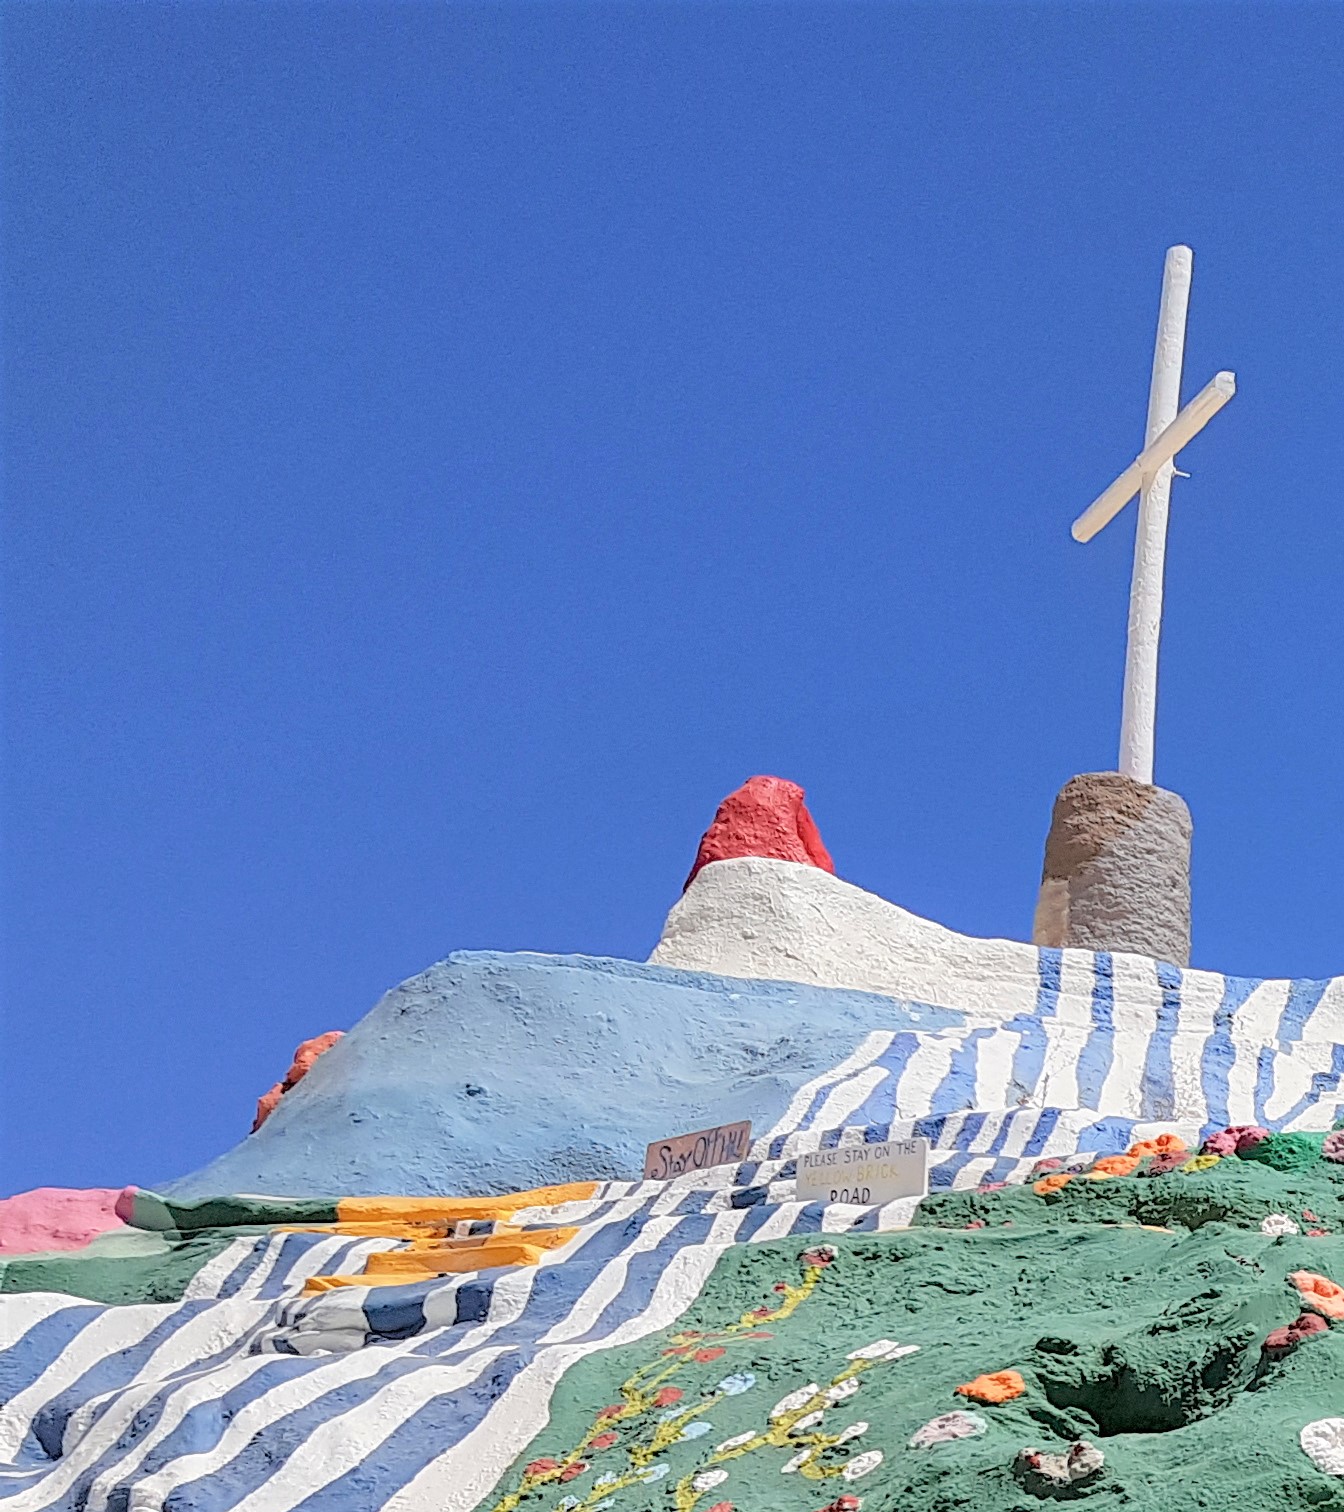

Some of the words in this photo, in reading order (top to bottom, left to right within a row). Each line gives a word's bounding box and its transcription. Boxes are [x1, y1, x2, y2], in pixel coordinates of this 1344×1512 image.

[651, 1145, 692, 1179] Stay
[803, 1152, 838, 1168] PLEASE
[844, 1148, 871, 1164] STAY
[874, 1146, 890, 1159] ON
[897, 1140, 917, 1155] THE
[805, 1168, 849, 1187] YELLOW
[857, 1163, 898, 1182] BRICK
[830, 1187, 871, 1204] ROAD
